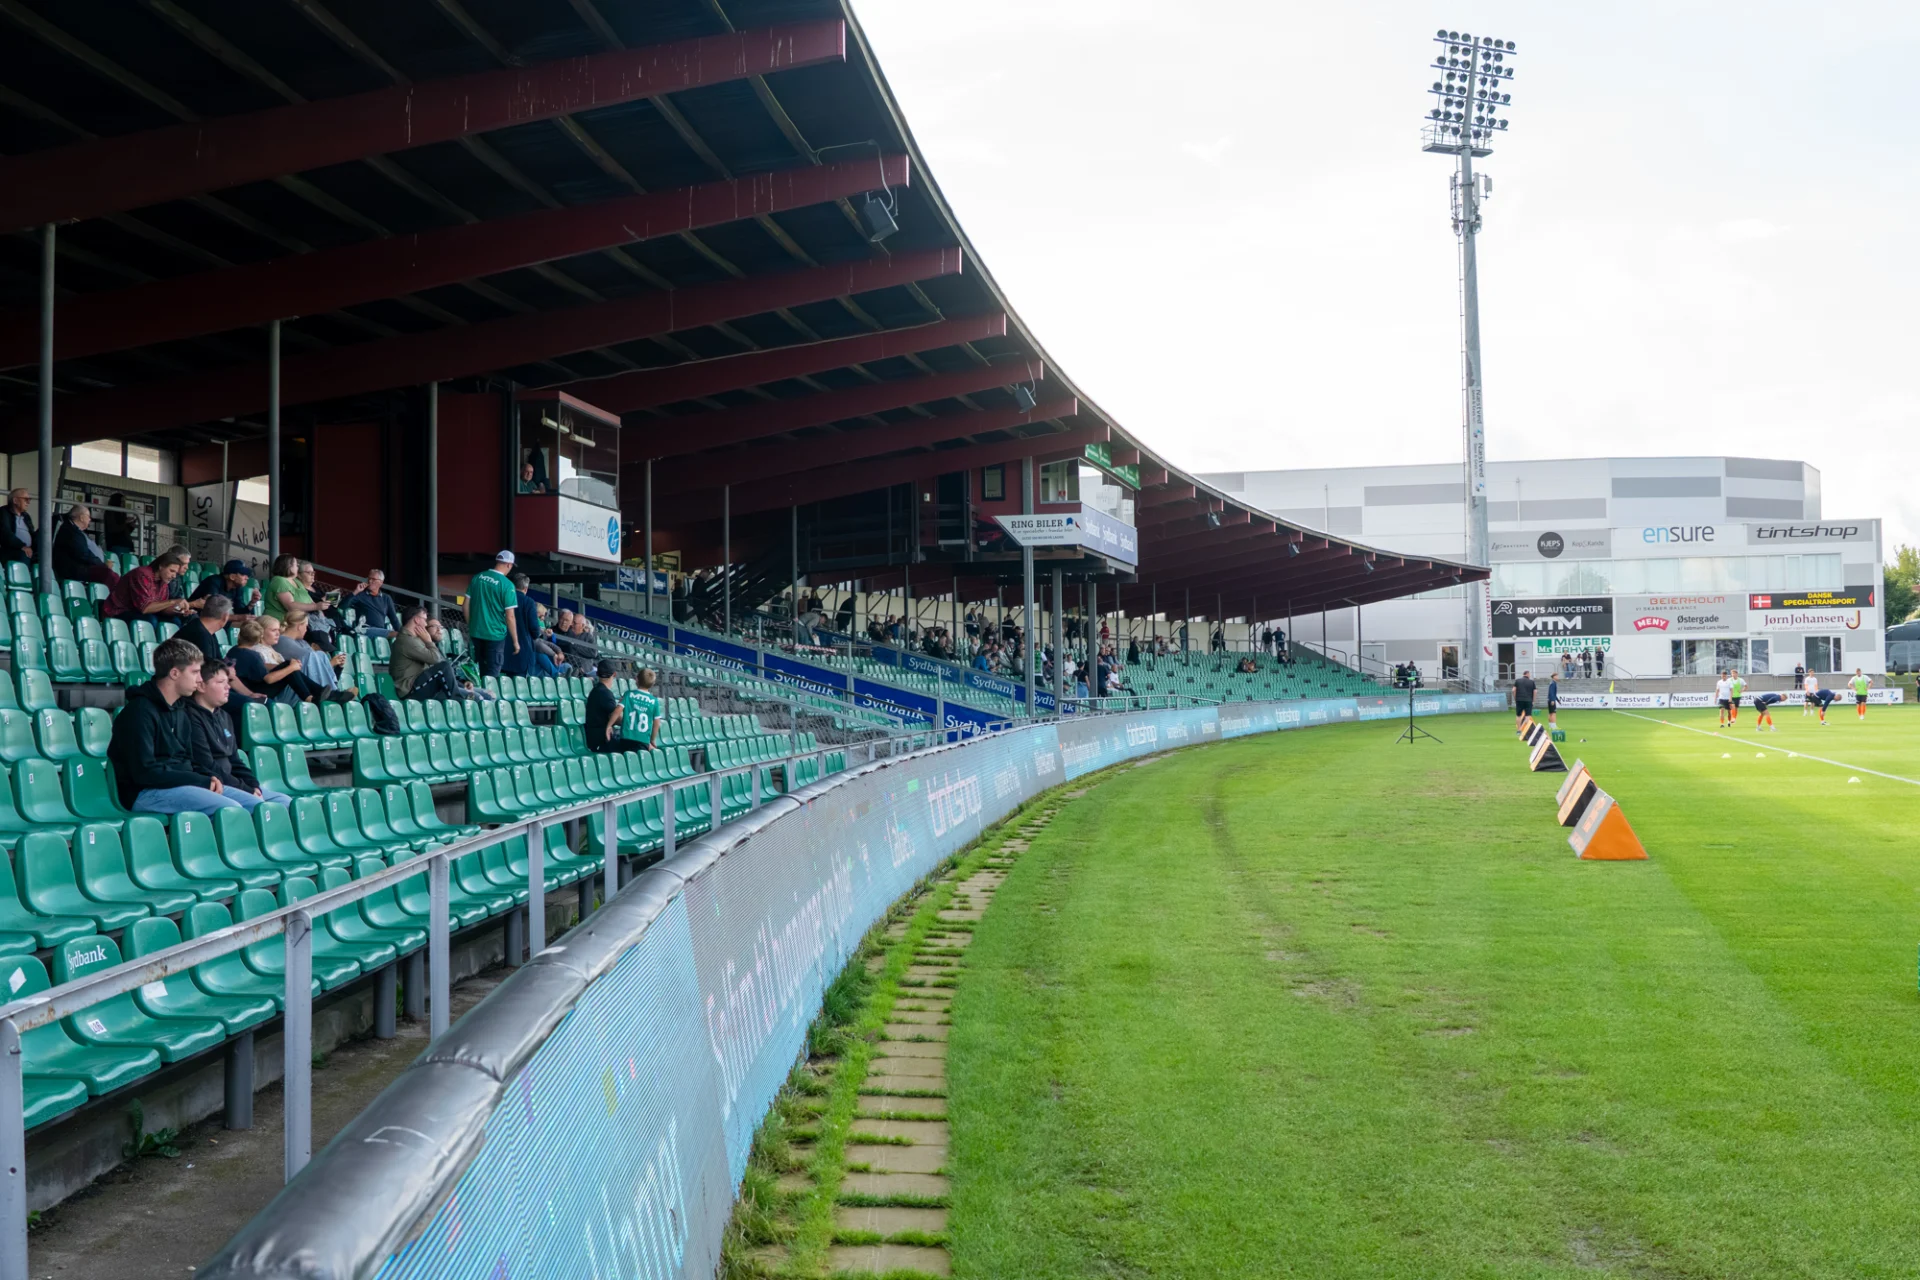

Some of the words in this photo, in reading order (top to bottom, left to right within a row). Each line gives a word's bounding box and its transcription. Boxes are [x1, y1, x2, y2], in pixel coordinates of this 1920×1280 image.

[1011, 520, 1034, 529] RING
[1036, 519, 1063, 528] BILER
[1643, 526, 1715, 543] ensure
[1756, 525, 1858, 539] tintshop
[479, 574, 499, 585] MTM
[1649, 596, 1725, 605] BEIERHOLM
[1783, 598, 1856, 606] SPECIALTRANSPORT
[1517, 606, 1546, 614] RODI'S
[1547, 605, 1603, 614] AUTOCENTER
[1517, 616, 1582, 631] MTM
[1636, 617, 1667, 628] MENY
[1677, 614, 1719, 625] Østergade
[1554, 637, 1611, 646] MISTER
[908, 657, 953, 678] Sydbank
[629, 692, 656, 705] MTM
[1558, 695, 1594, 703] Næstved
[1673, 693, 1709, 702] Næstved
[629, 711, 649, 732] 18
